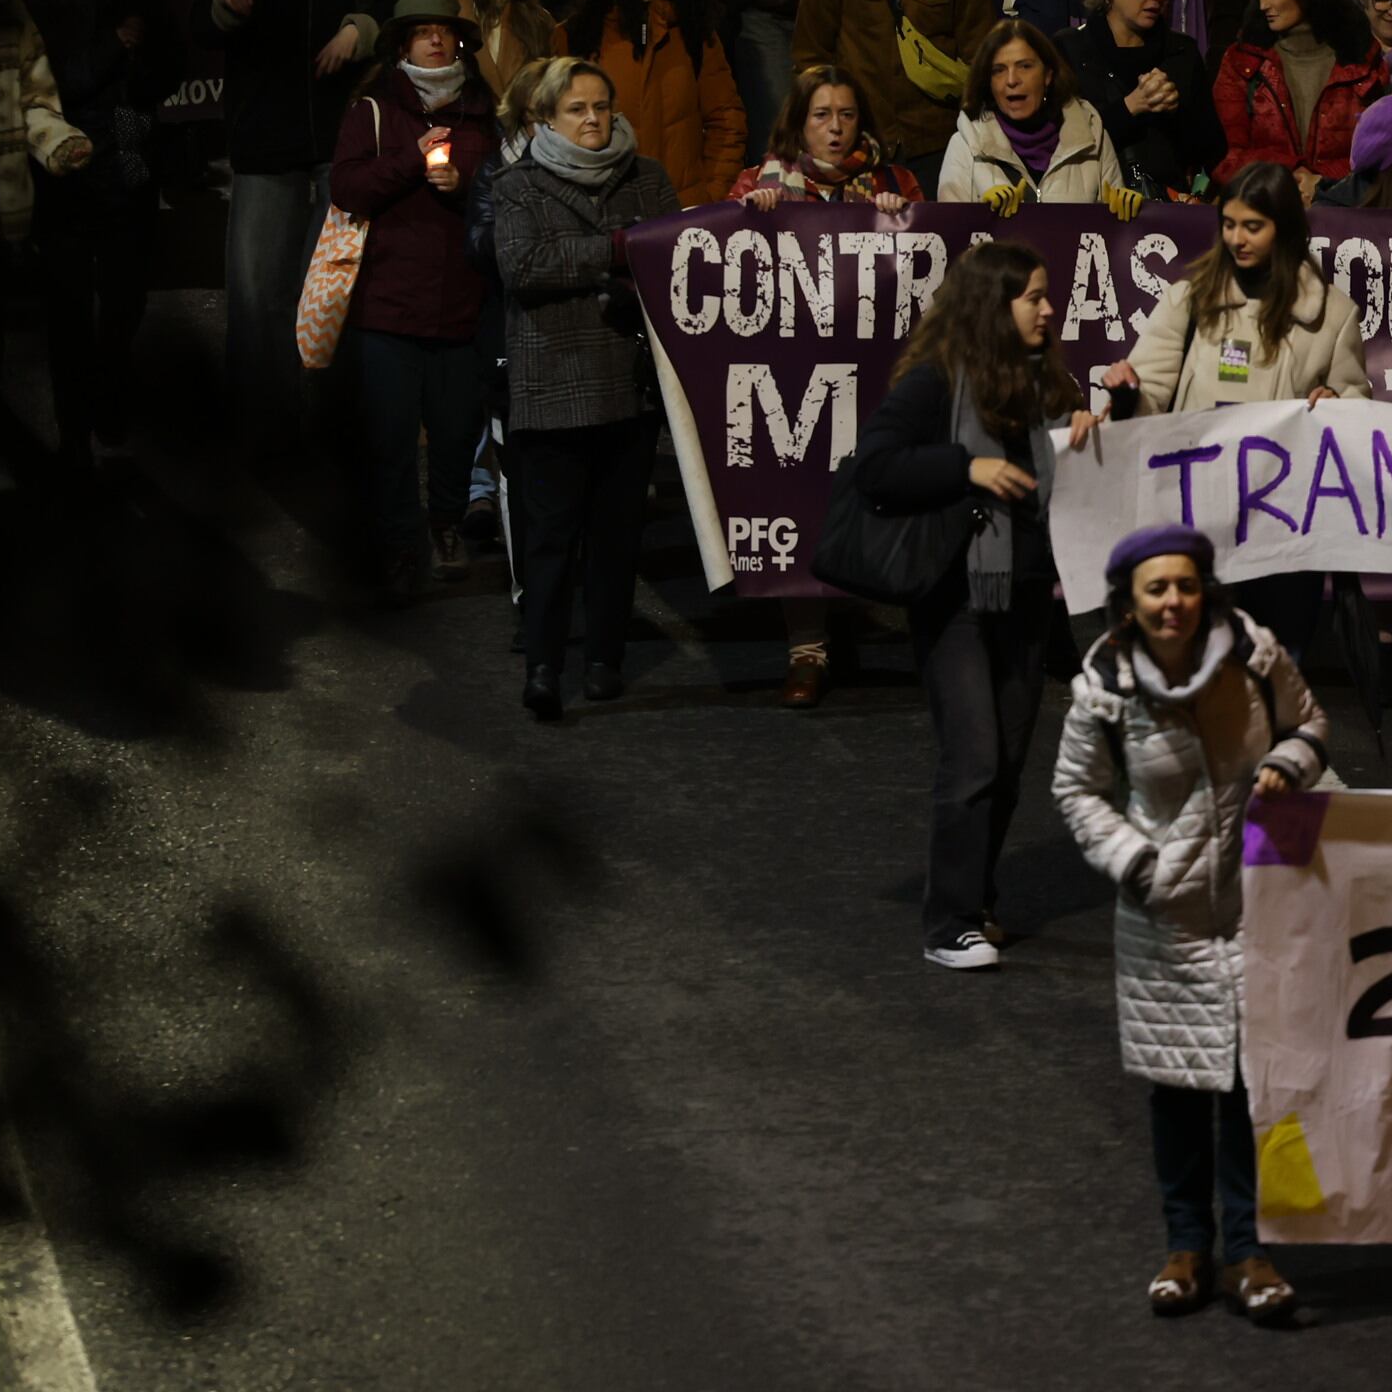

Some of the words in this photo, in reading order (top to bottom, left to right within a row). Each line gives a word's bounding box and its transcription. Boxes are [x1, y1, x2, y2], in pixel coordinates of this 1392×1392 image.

[669, 226, 995, 341] CONTR
[728, 516, 799, 554] PFG
[729, 551, 764, 572] Ames
